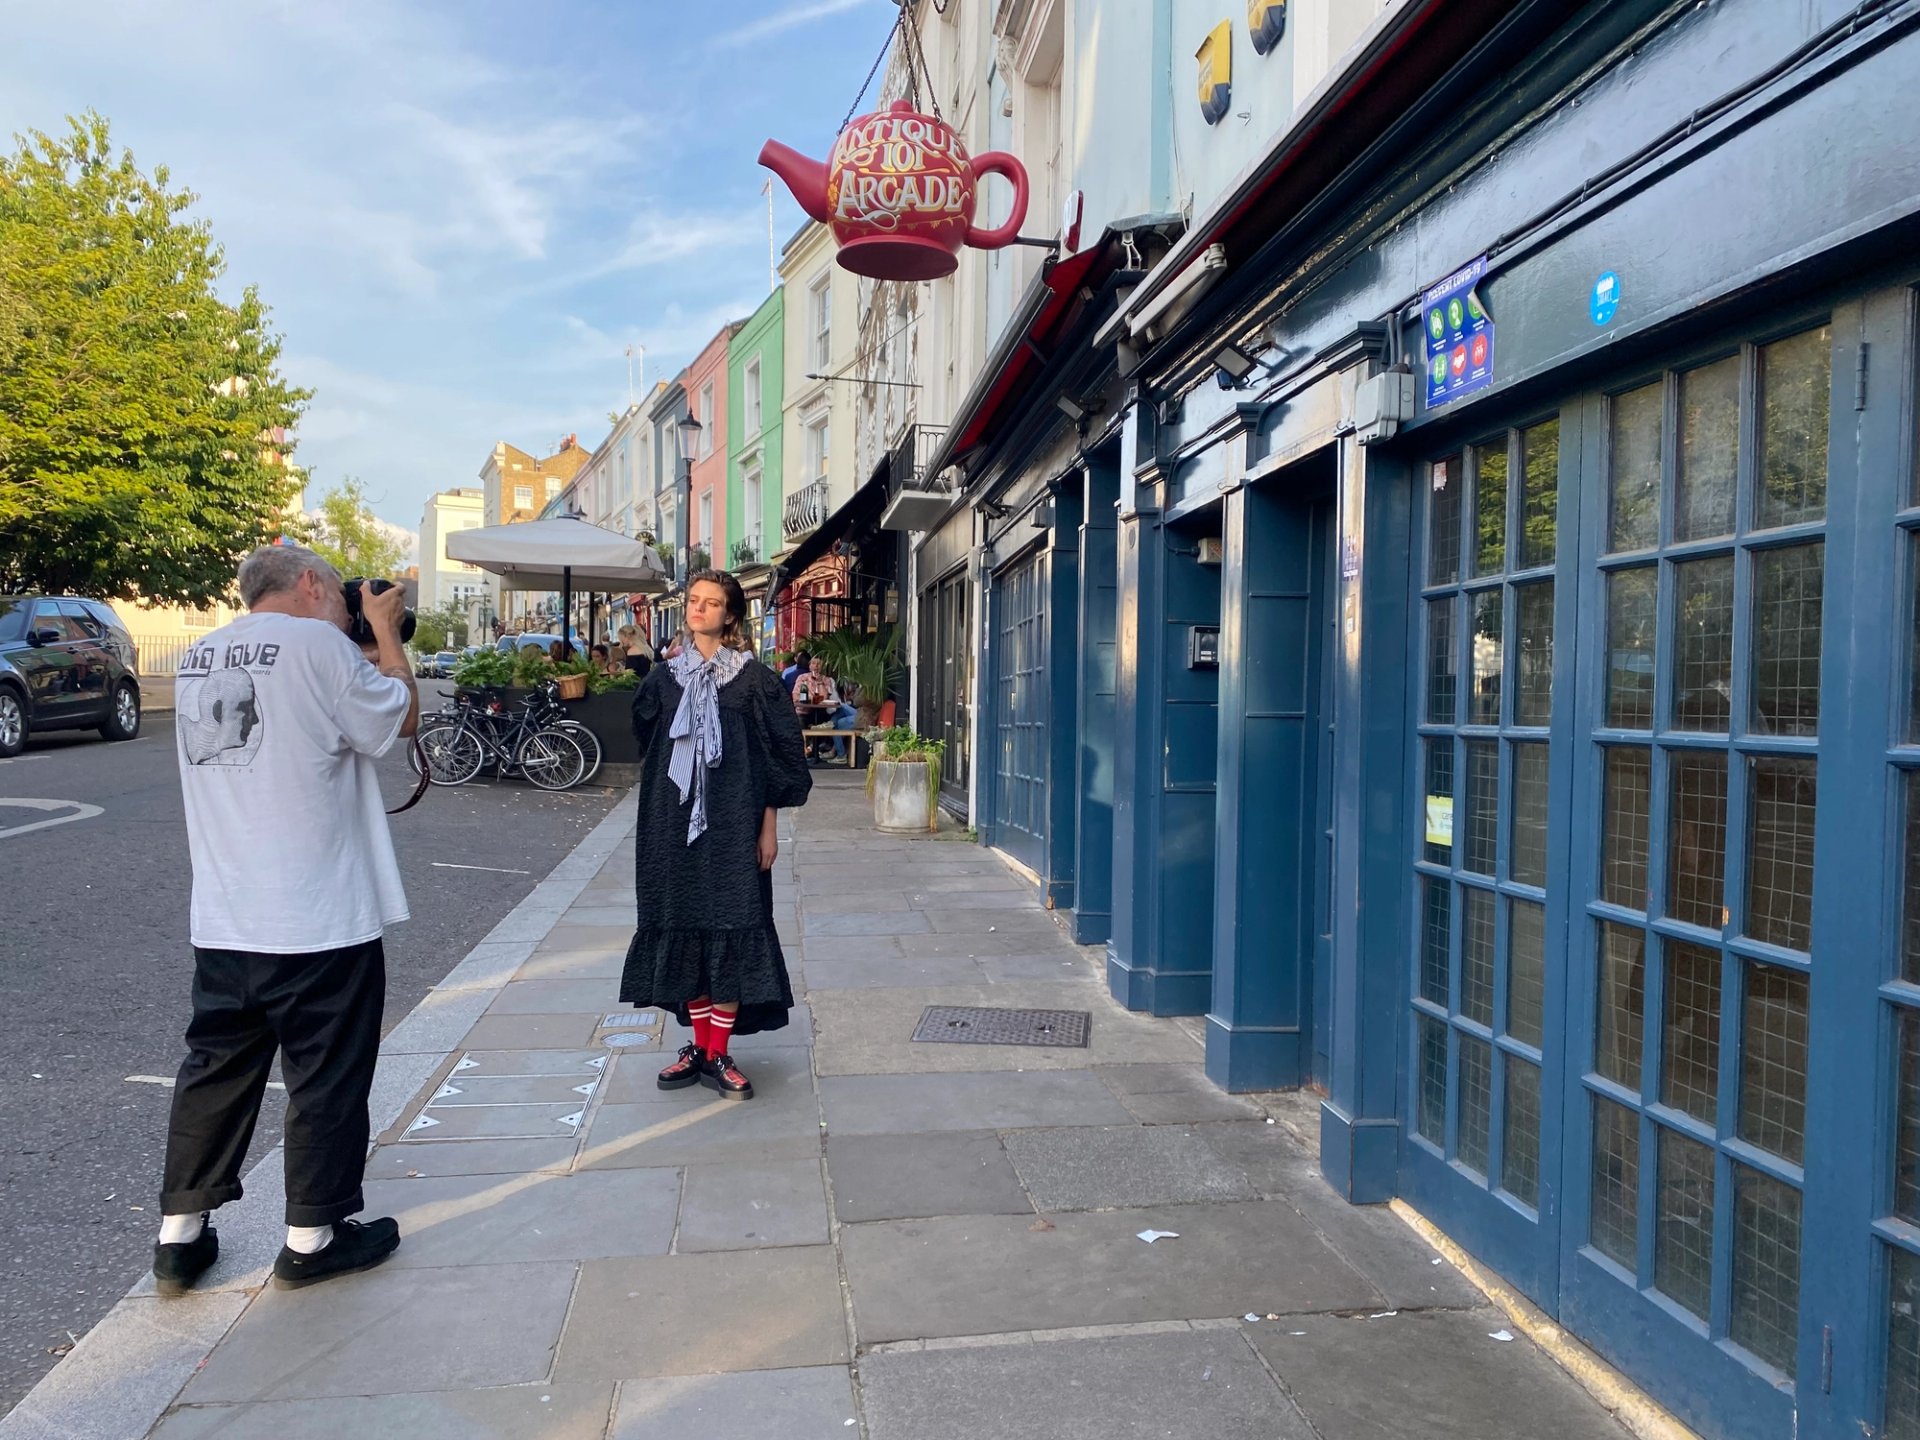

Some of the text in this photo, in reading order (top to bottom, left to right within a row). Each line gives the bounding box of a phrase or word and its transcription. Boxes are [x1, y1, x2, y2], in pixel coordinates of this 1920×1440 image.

[832, 116, 970, 173] ANTIQUE
[880, 141, 926, 173] 101
[835, 168, 970, 232] ARCADE
[224, 641, 280, 669] love
